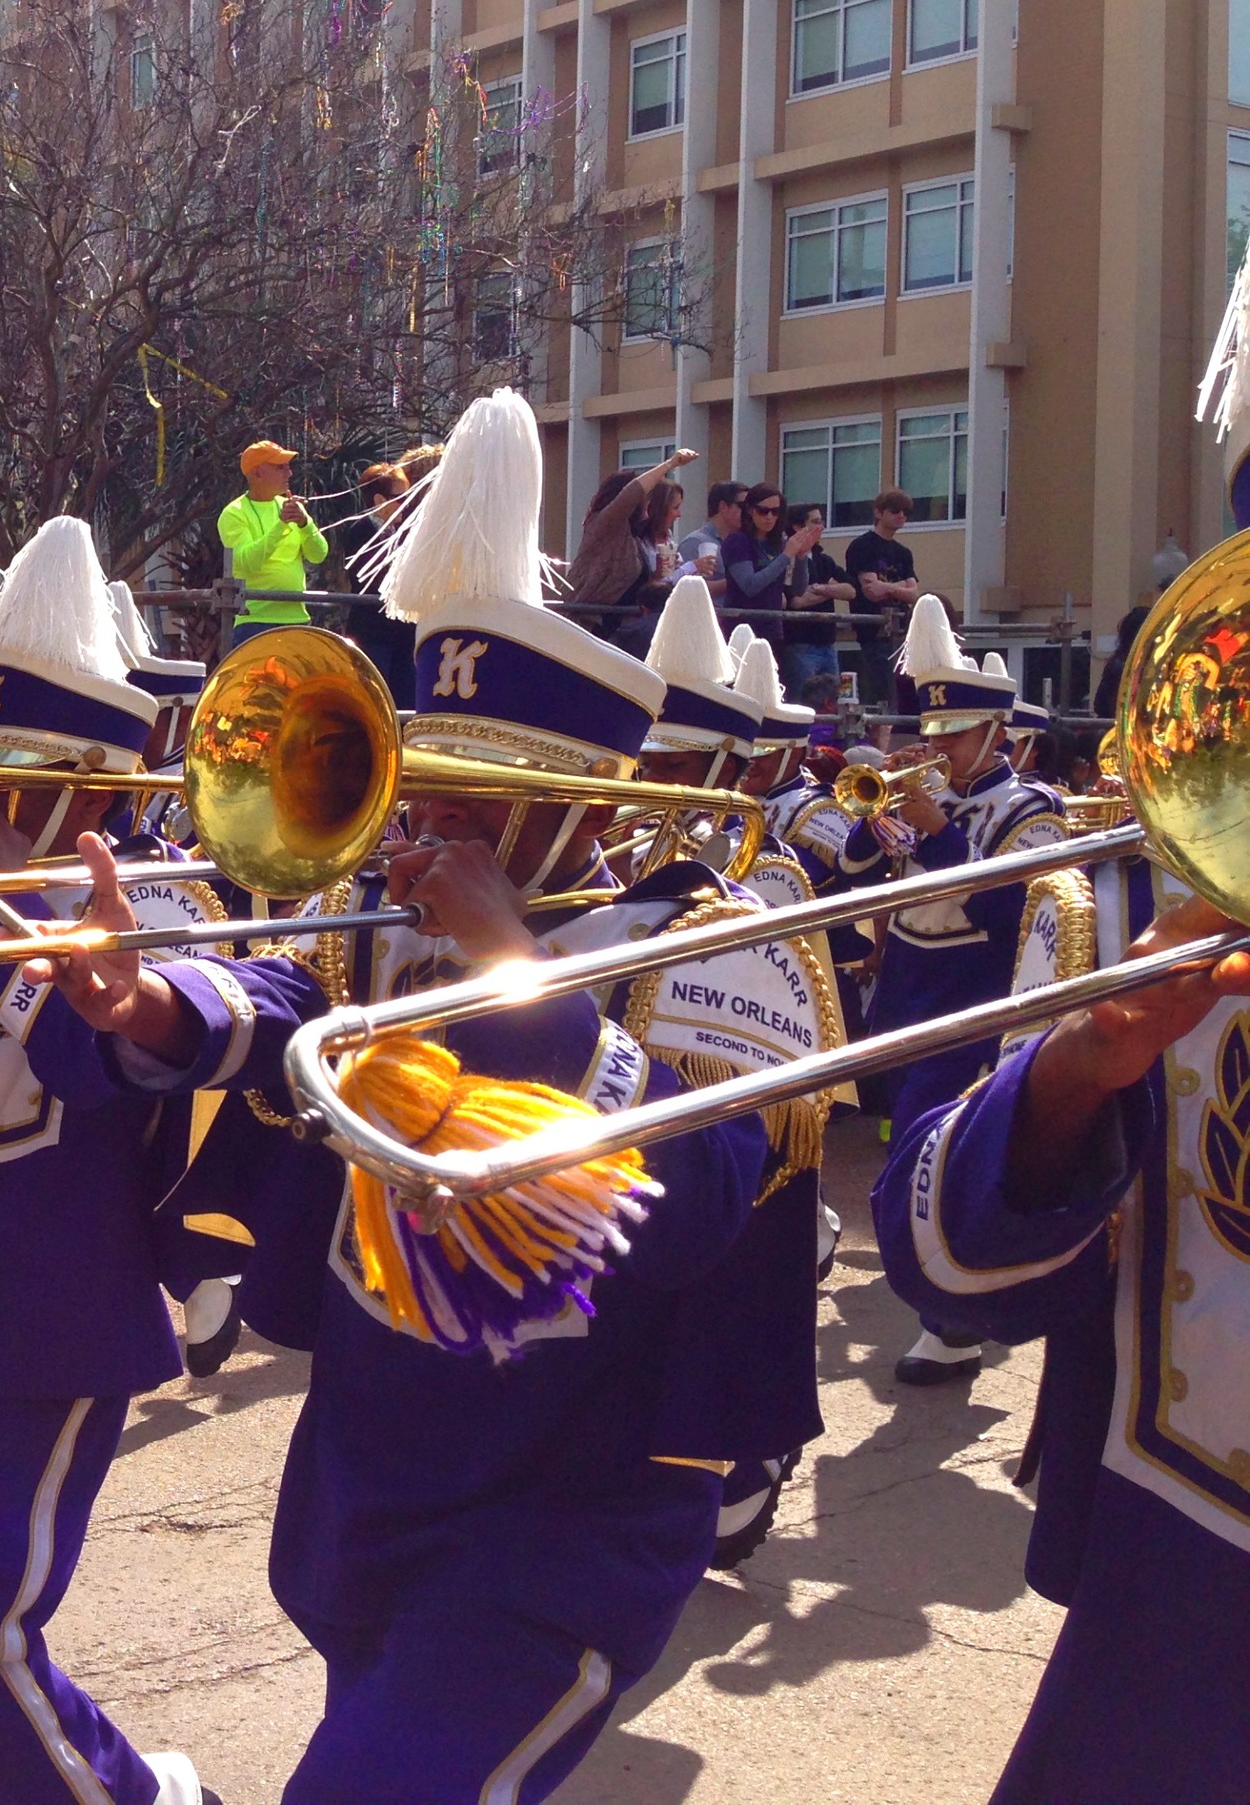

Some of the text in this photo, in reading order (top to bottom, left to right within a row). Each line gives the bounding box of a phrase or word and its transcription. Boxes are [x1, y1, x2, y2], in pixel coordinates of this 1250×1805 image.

[432, 637, 488, 699] K
[928, 684, 947, 706] K
[809, 817, 824, 828] NEW
[825, 825, 847, 840] ORLEA
[1029, 824, 1052, 834] EDNA
[126, 886, 174, 904] EDNA
[753, 871, 786, 884] EDNA
[787, 879, 802, 905] KAR
[764, 943, 808, 1008] KARR
[10, 982, 37, 1012] RR
[671, 981, 812, 1048] NEW ORLEANS
[695, 1031, 787, 1067] SECOND TO NO
